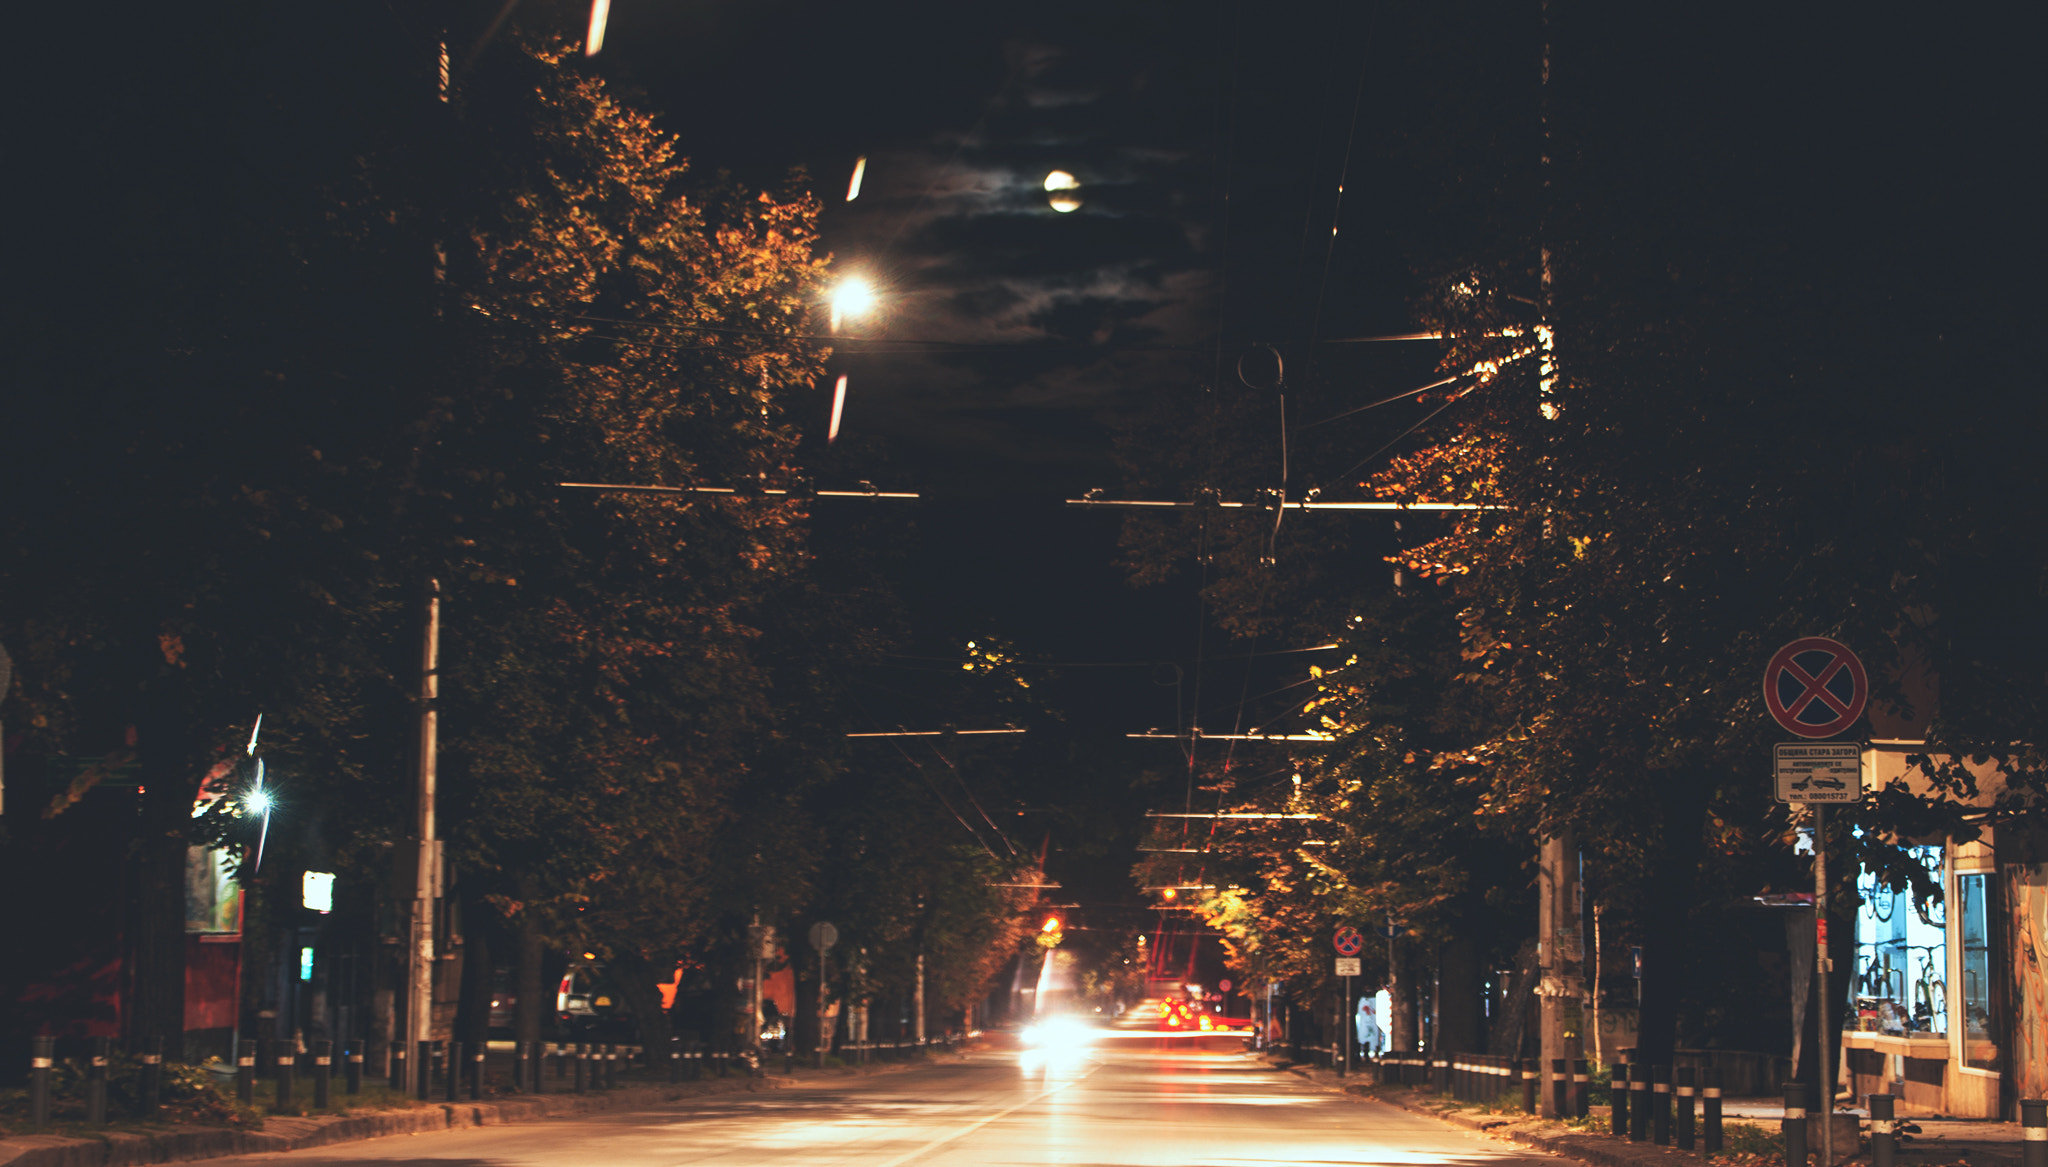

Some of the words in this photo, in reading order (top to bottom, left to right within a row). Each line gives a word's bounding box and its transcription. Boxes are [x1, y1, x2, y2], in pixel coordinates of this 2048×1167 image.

[1779, 748, 1808, 756] ОБЩИНА
[1809, 748, 1831, 756] СТАРА
[1832, 748, 1857, 756] ЗАГОРА
